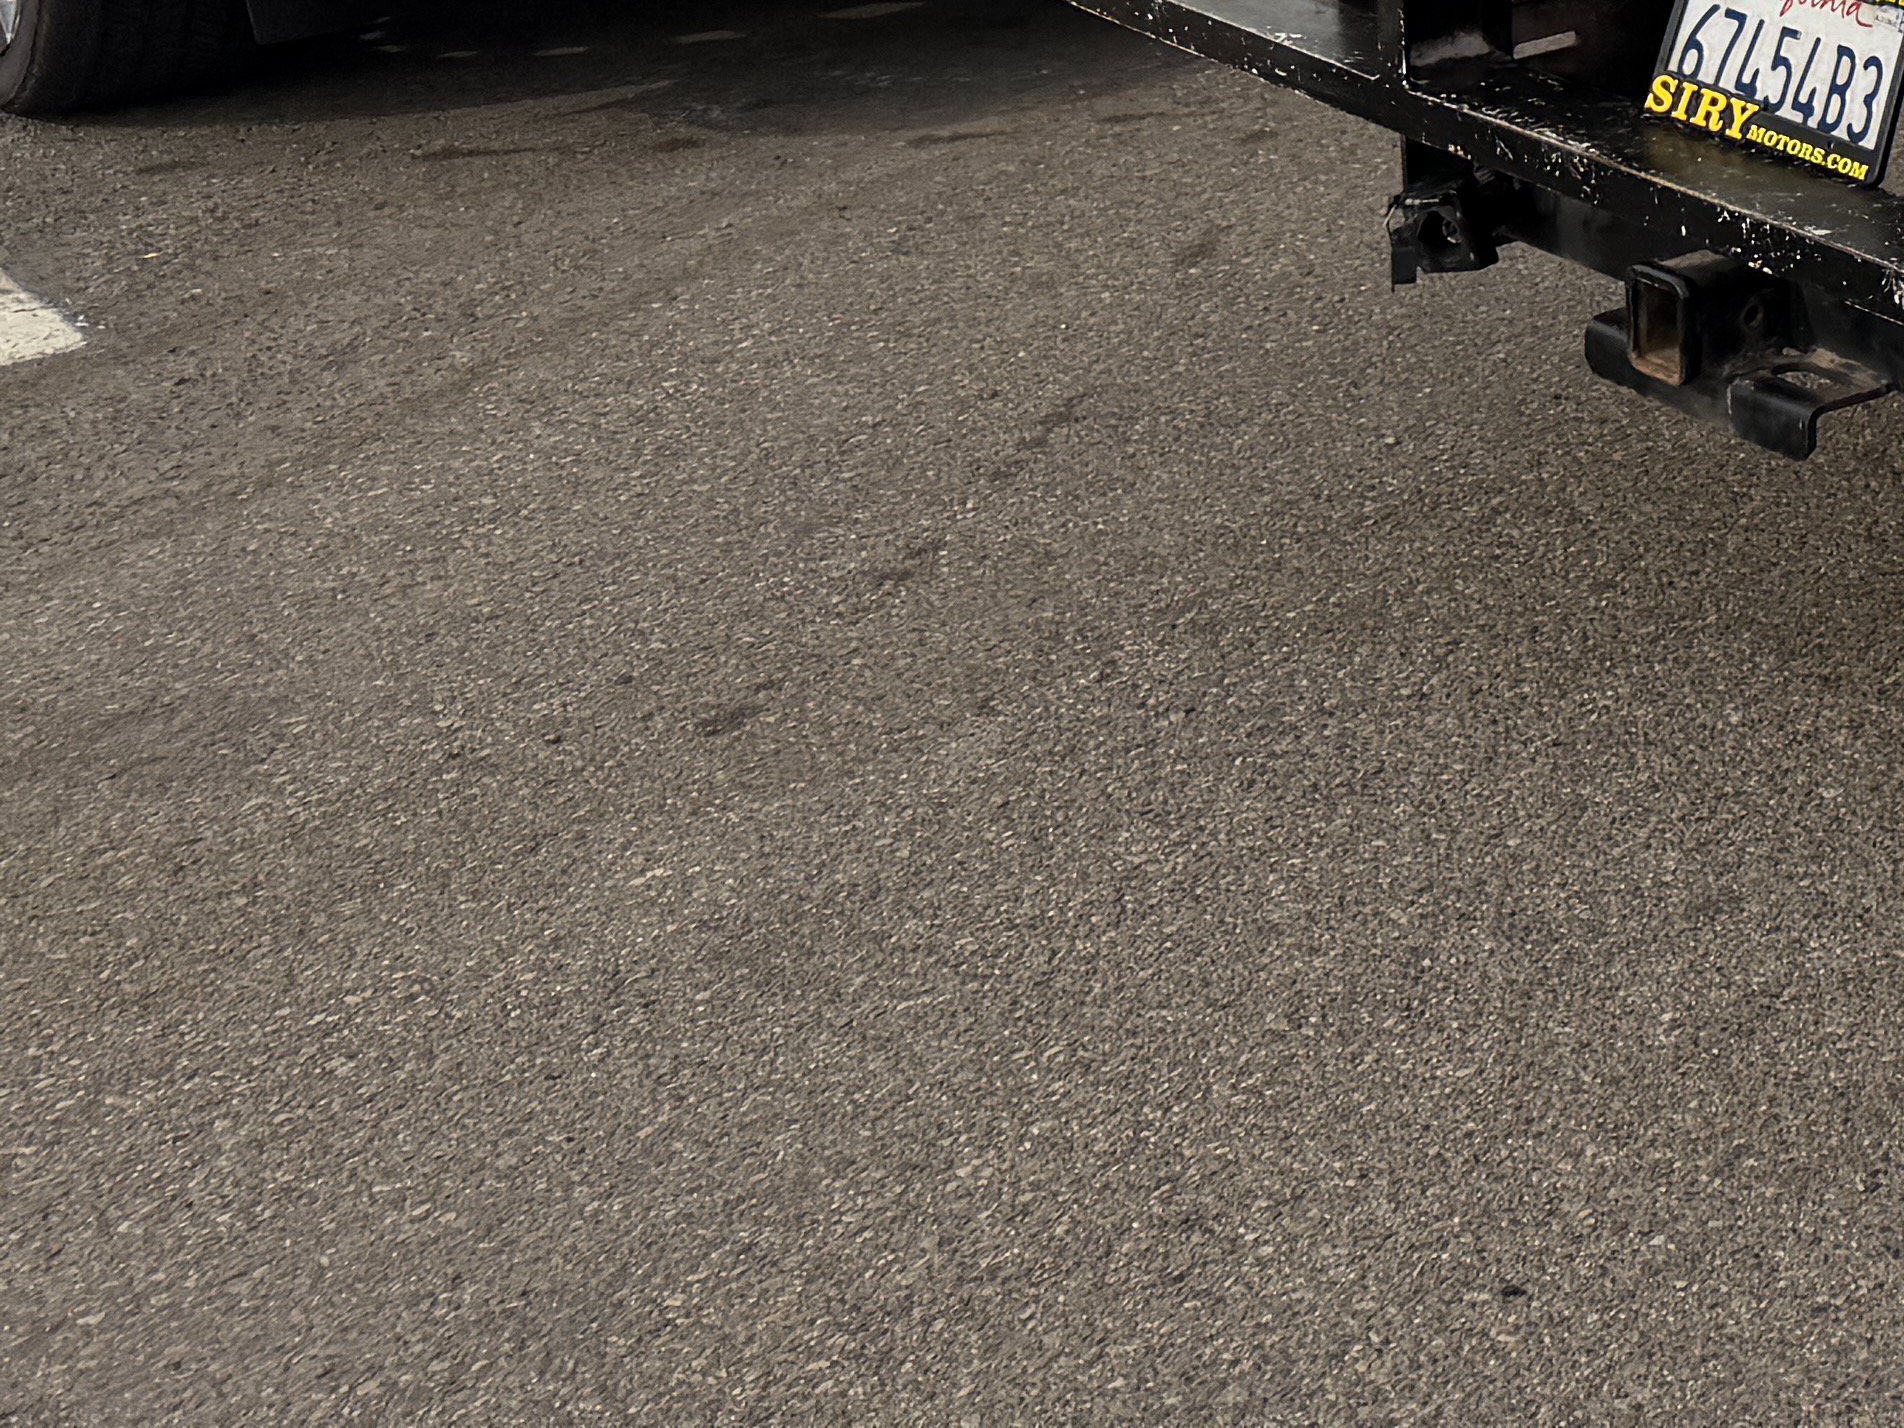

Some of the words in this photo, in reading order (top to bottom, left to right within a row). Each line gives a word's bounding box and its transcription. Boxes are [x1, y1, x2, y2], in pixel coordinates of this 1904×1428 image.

[1644, 74, 1760, 140] SIRY
[1746, 123, 1870, 182] MOTORS.COM
[1679, 3, 1884, 143] 67454B3
